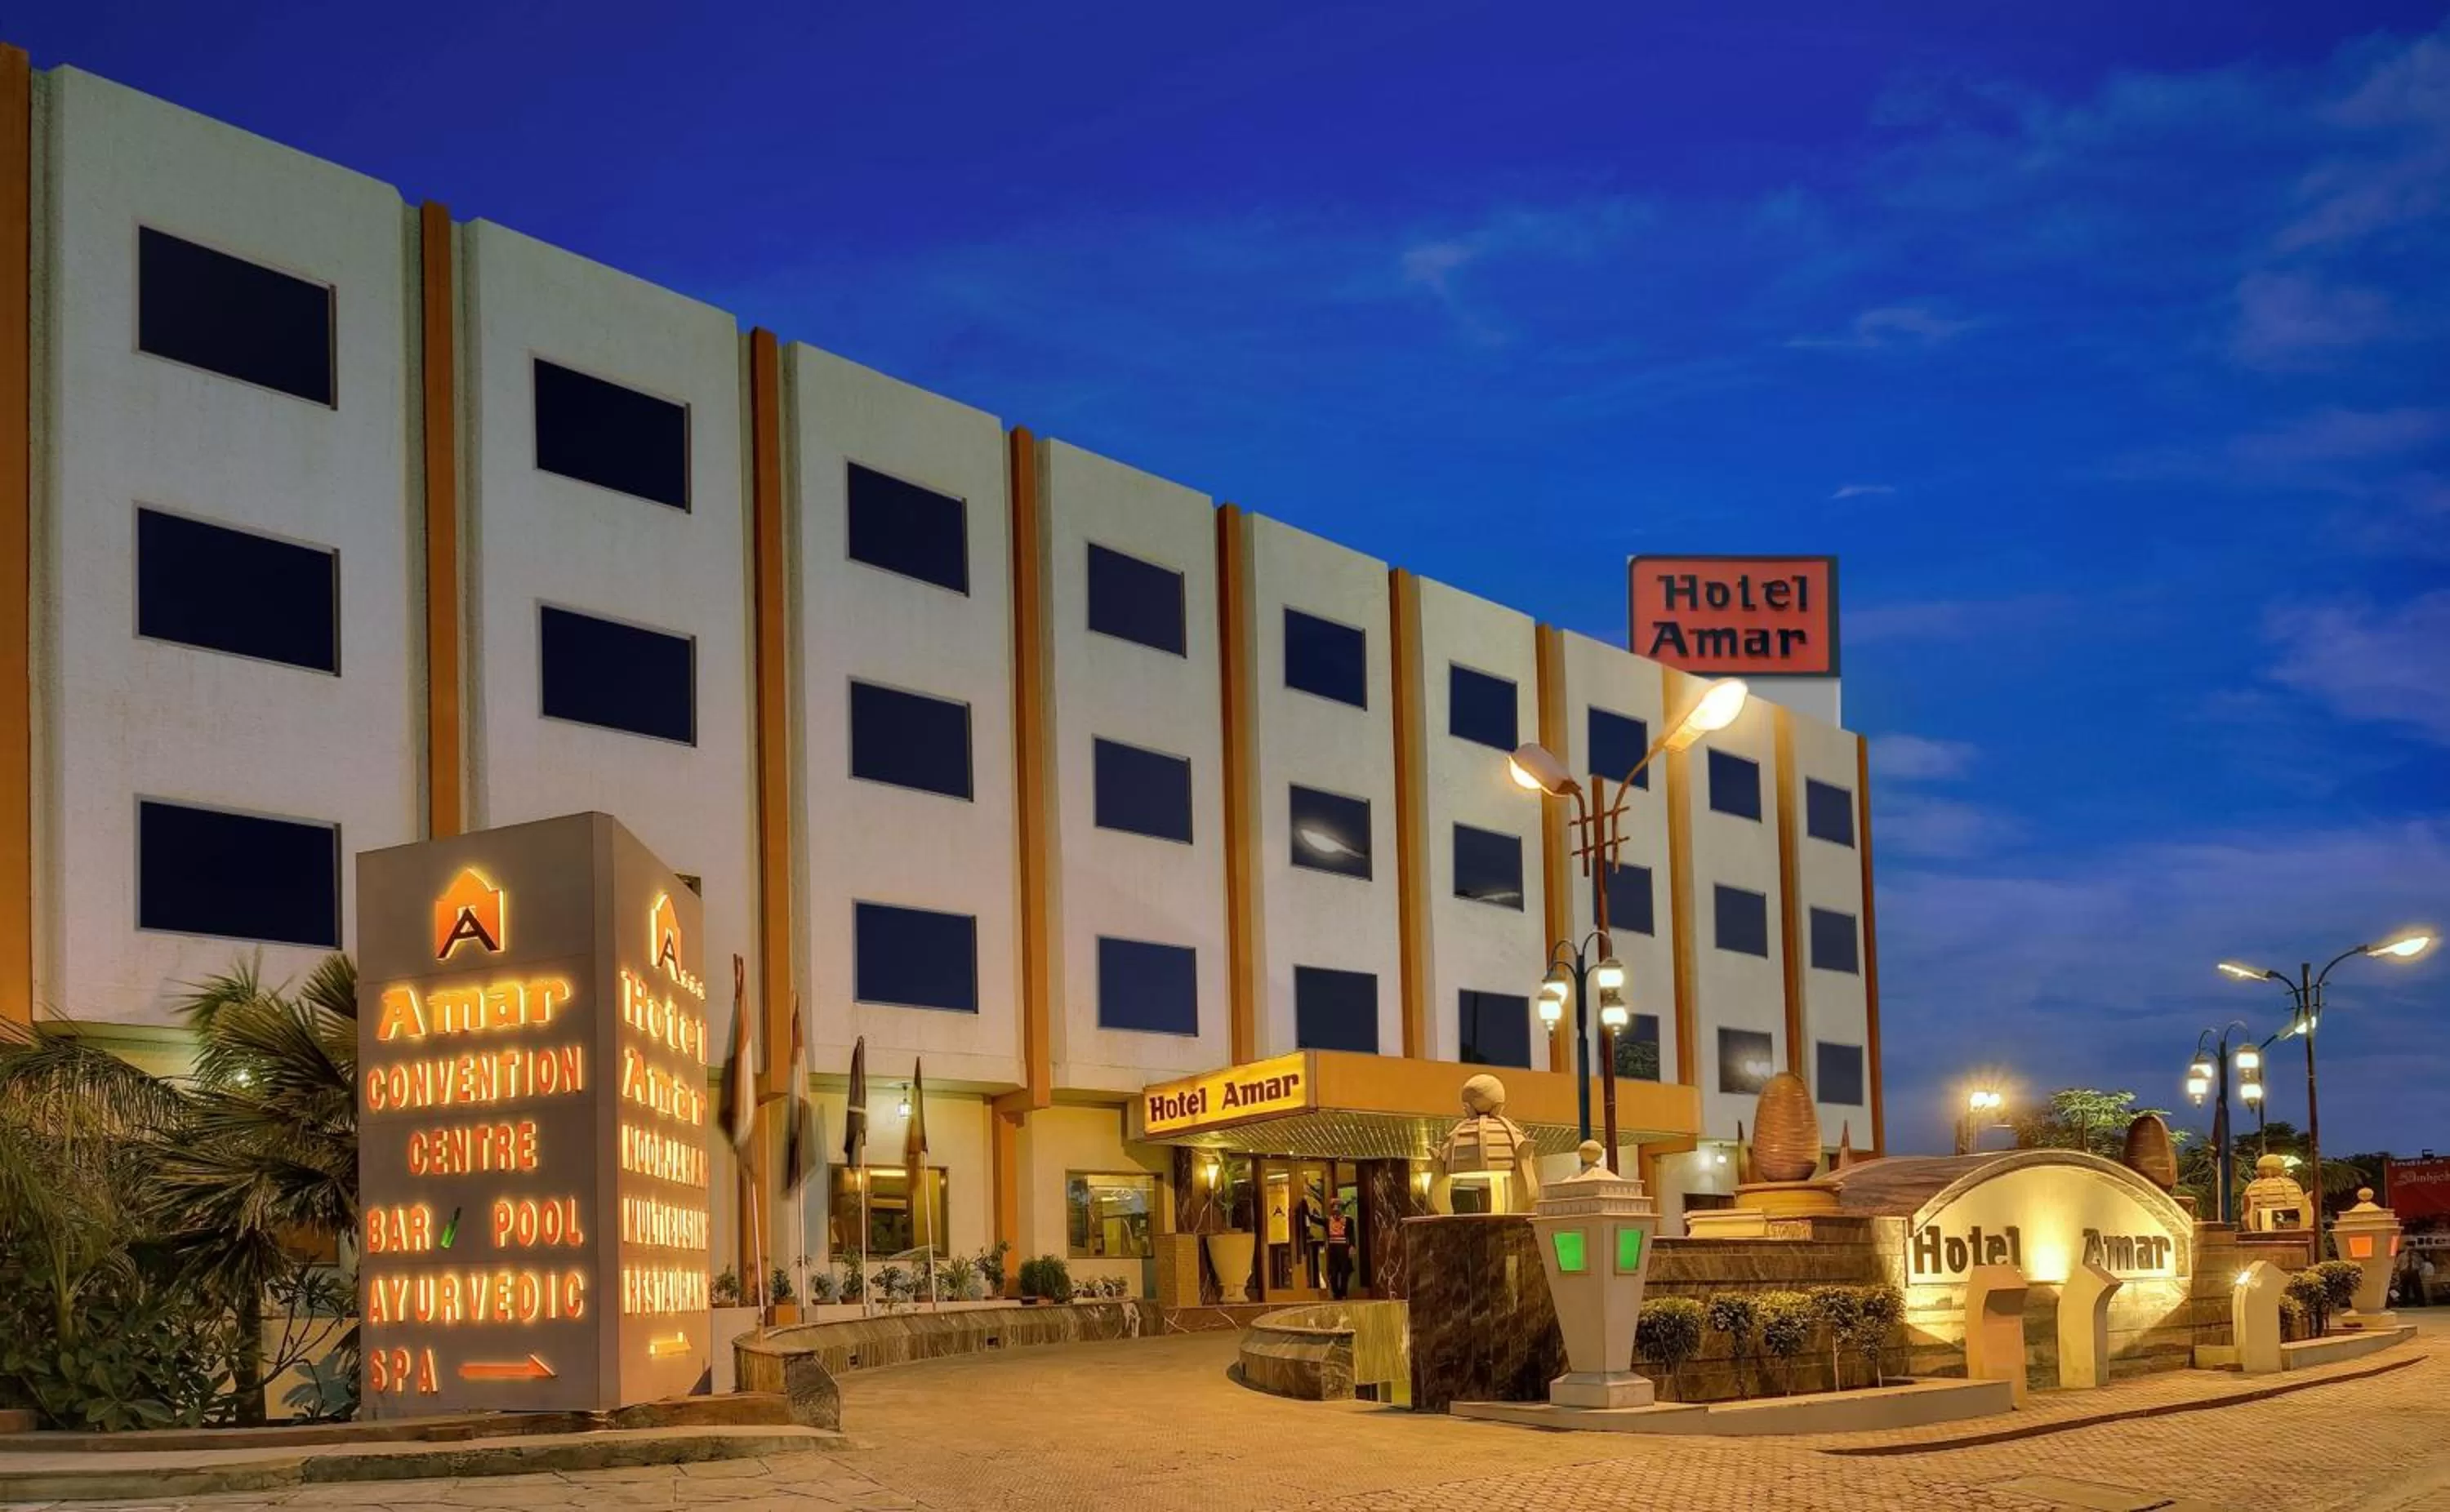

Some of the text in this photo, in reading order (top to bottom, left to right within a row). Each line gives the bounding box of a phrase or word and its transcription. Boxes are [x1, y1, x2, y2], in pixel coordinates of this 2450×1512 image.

[1657, 574, 1808, 613] Hotel
[1648, 620, 1808, 658] Amar
[377, 979, 571, 1042] Amar
[621, 969, 707, 1066] Hotel
[367, 1045, 583, 1111] CONVENTION
[621, 1047, 708, 1127] Amar
[1149, 1073, 1299, 1123] Hotel Amar
[408, 1120, 538, 1176] CENTRE
[367, 1204, 433, 1254] BAR
[493, 1197, 585, 1247] POOL
[1913, 1225, 2172, 1274] Hotel Amar
[368, 1270, 586, 1325] AYURVEDIC
[370, 1347, 439, 1394] SPA
